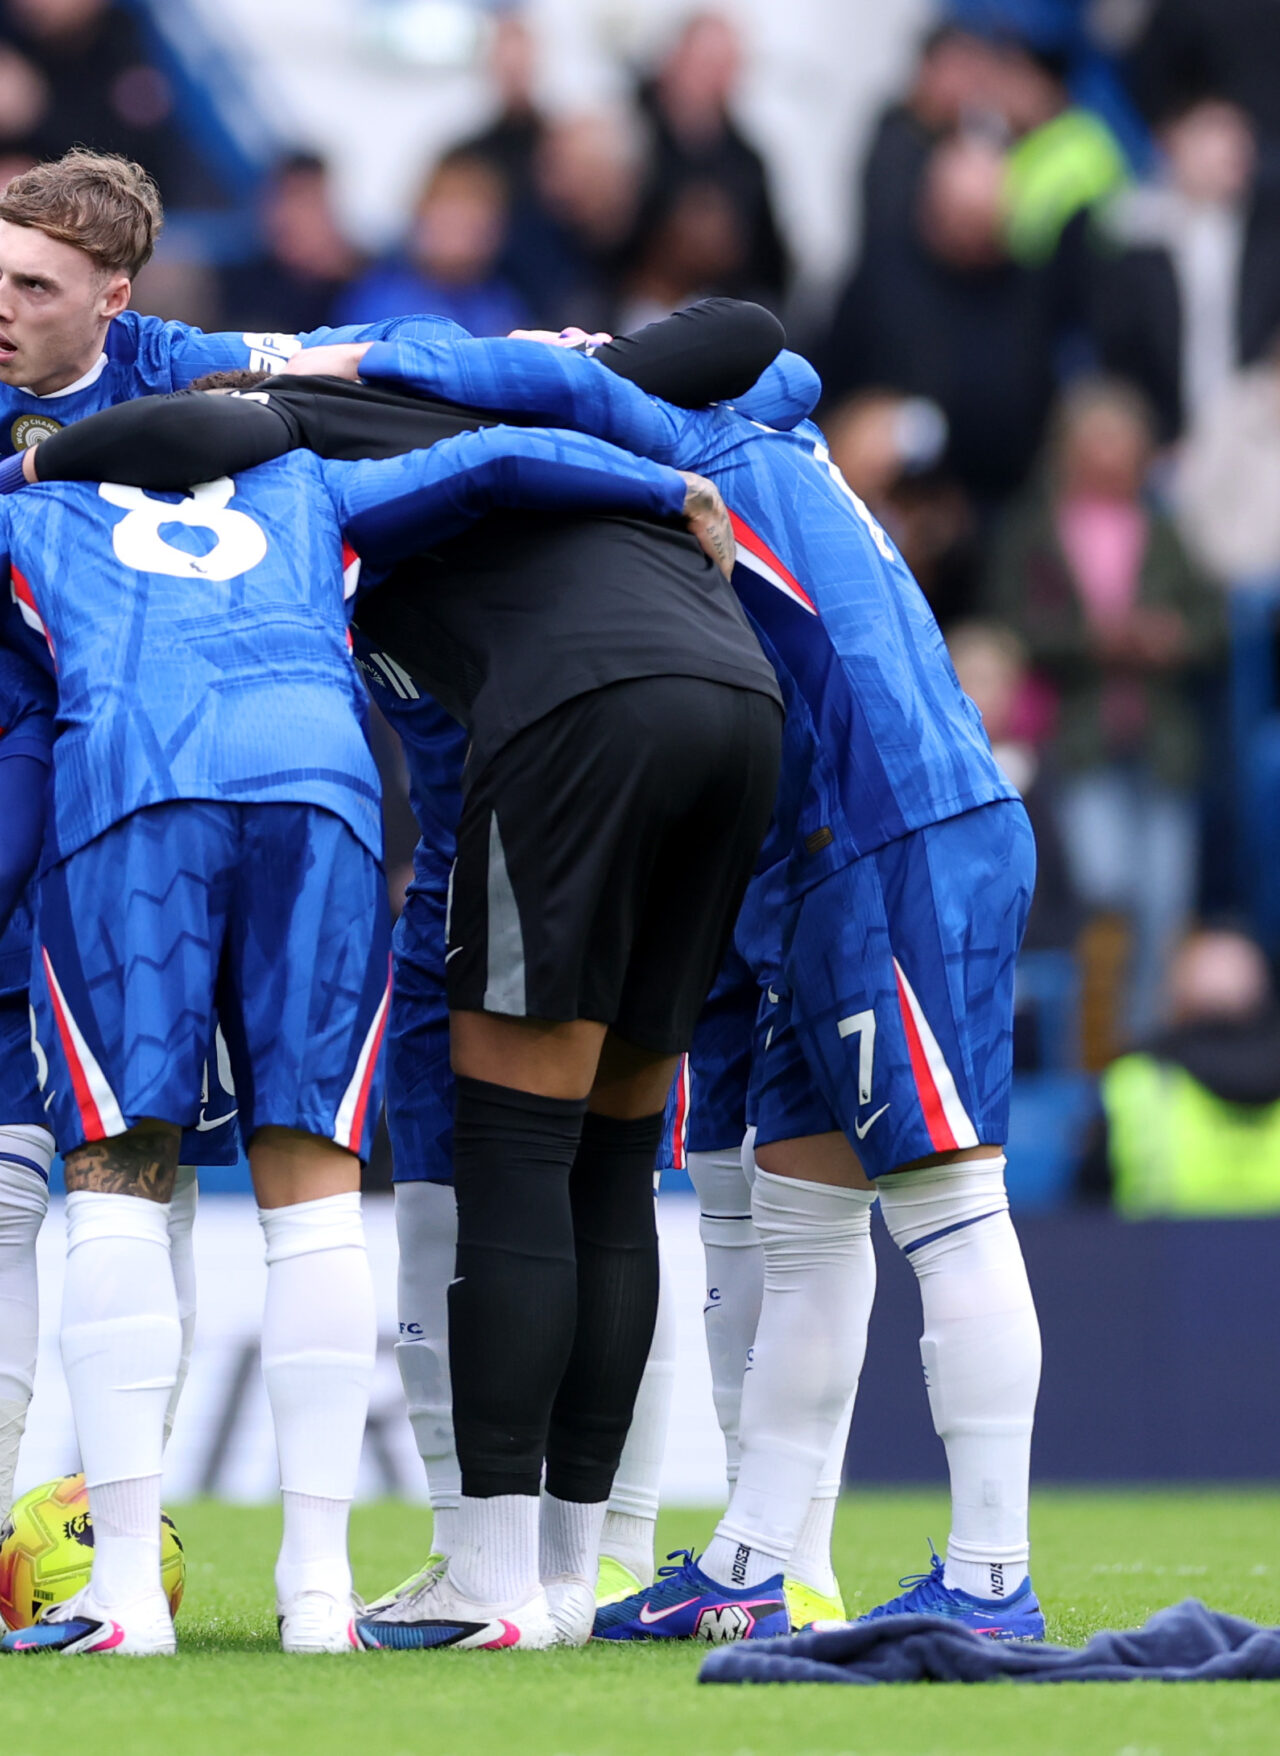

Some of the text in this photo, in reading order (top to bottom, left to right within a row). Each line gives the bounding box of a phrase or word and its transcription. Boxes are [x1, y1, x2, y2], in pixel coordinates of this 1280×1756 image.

[16, 421, 29, 445] WORLD
[98, 476, 268, 582] 8
[837, 1008, 877, 1106] 7
